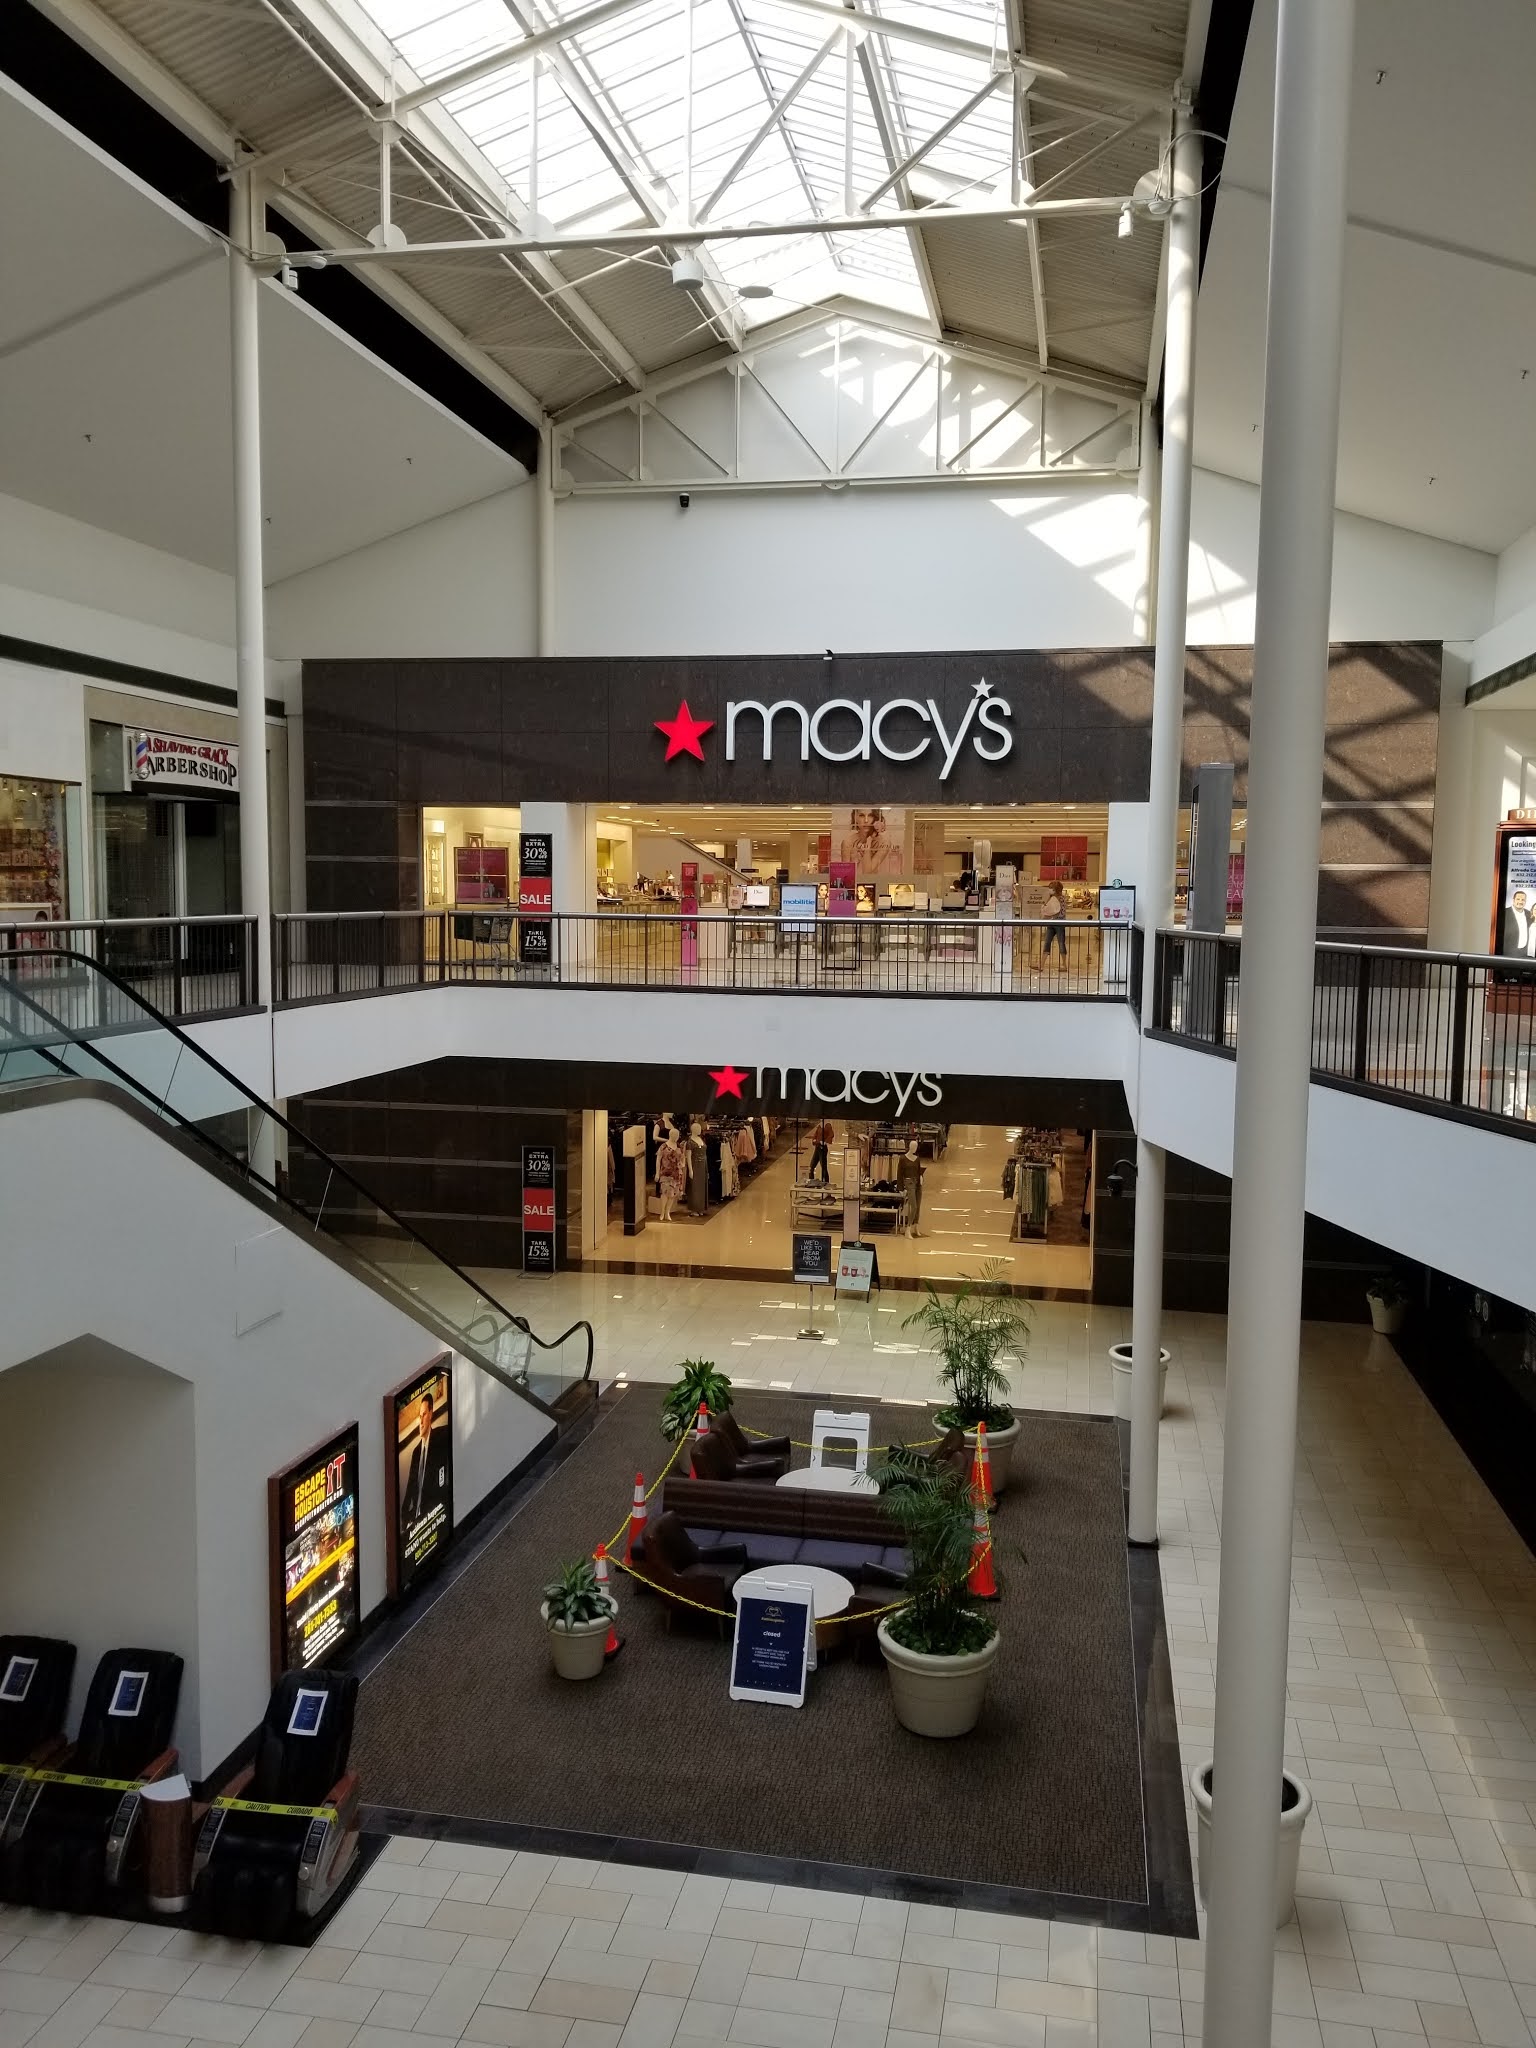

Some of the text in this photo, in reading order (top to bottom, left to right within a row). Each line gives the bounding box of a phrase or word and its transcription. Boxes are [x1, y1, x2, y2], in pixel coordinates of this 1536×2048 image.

[726, 677, 1012, 780] macy's
[153, 738, 197, 756] SHAVING
[198, 747, 229, 767] GRACE
[520, 894, 552, 905] SALE
[524, 1205, 554, 1216] SALE
[528, 1246, 550, 1256] 15%
[295, 1467, 326, 1505] ESCAPE
[295, 1485, 326, 1523] HOUSTON
[245, 1802, 272, 1811] CAUTION
[286, 1807, 313, 1815] CUIDADO
